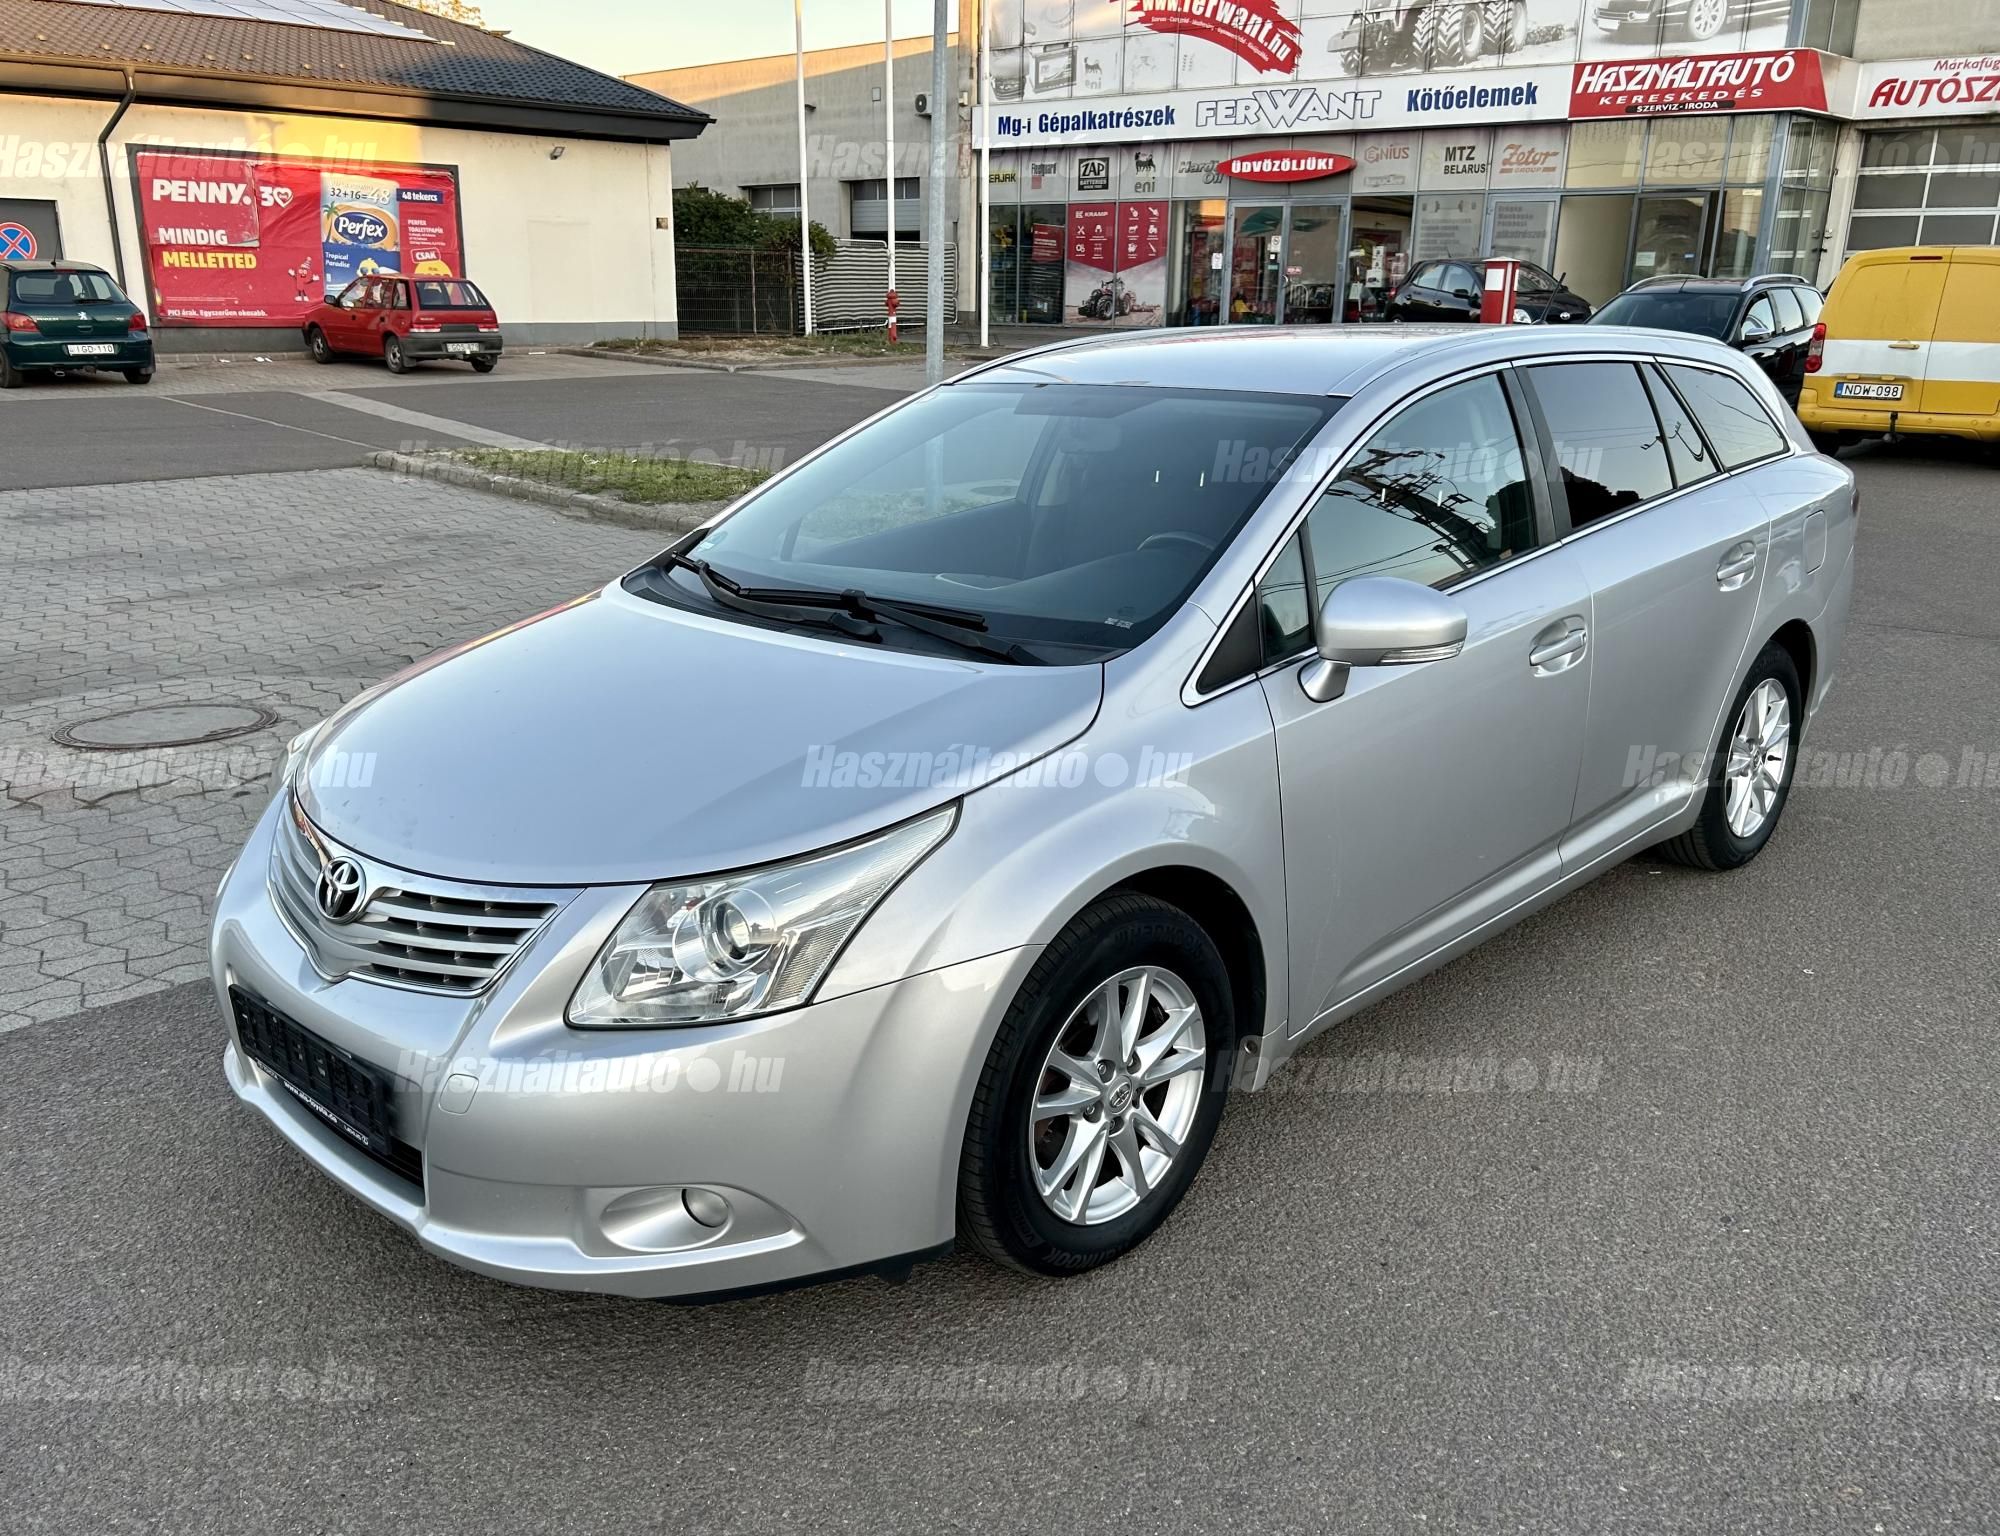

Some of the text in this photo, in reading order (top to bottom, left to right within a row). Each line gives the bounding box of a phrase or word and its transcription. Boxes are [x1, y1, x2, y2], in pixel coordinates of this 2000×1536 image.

[1575, 51, 1796, 94] HASZNÁLTAUTÓ
[1406, 81, 1539, 112] Kötőelemek
[1599, 88, 1764, 105] KERESKEDÉS
[997, 105, 1176, 137] Mg-i Gépalkatrészek
[1444, 146, 1476, 162] MTZ
[1501, 143, 1560, 166] Zetor
[1081, 161, 1105, 177] ZAP
[1231, 157, 1334, 173] ÜDVÖZÖLJÜK!
[1443, 163, 1486, 175] BELARUS
[1134, 177, 1156, 193] eni
[158, 227, 228, 245] MINDIG
[338, 217, 384, 240] Perfex
[162, 251, 257, 269] MELLETTED
[325, 252, 349, 261] Tropical
[415, 251, 437, 260] CSAK
[325, 260, 350, 268] Paradise
[1844, 384, 1899, 397] NDW-098
